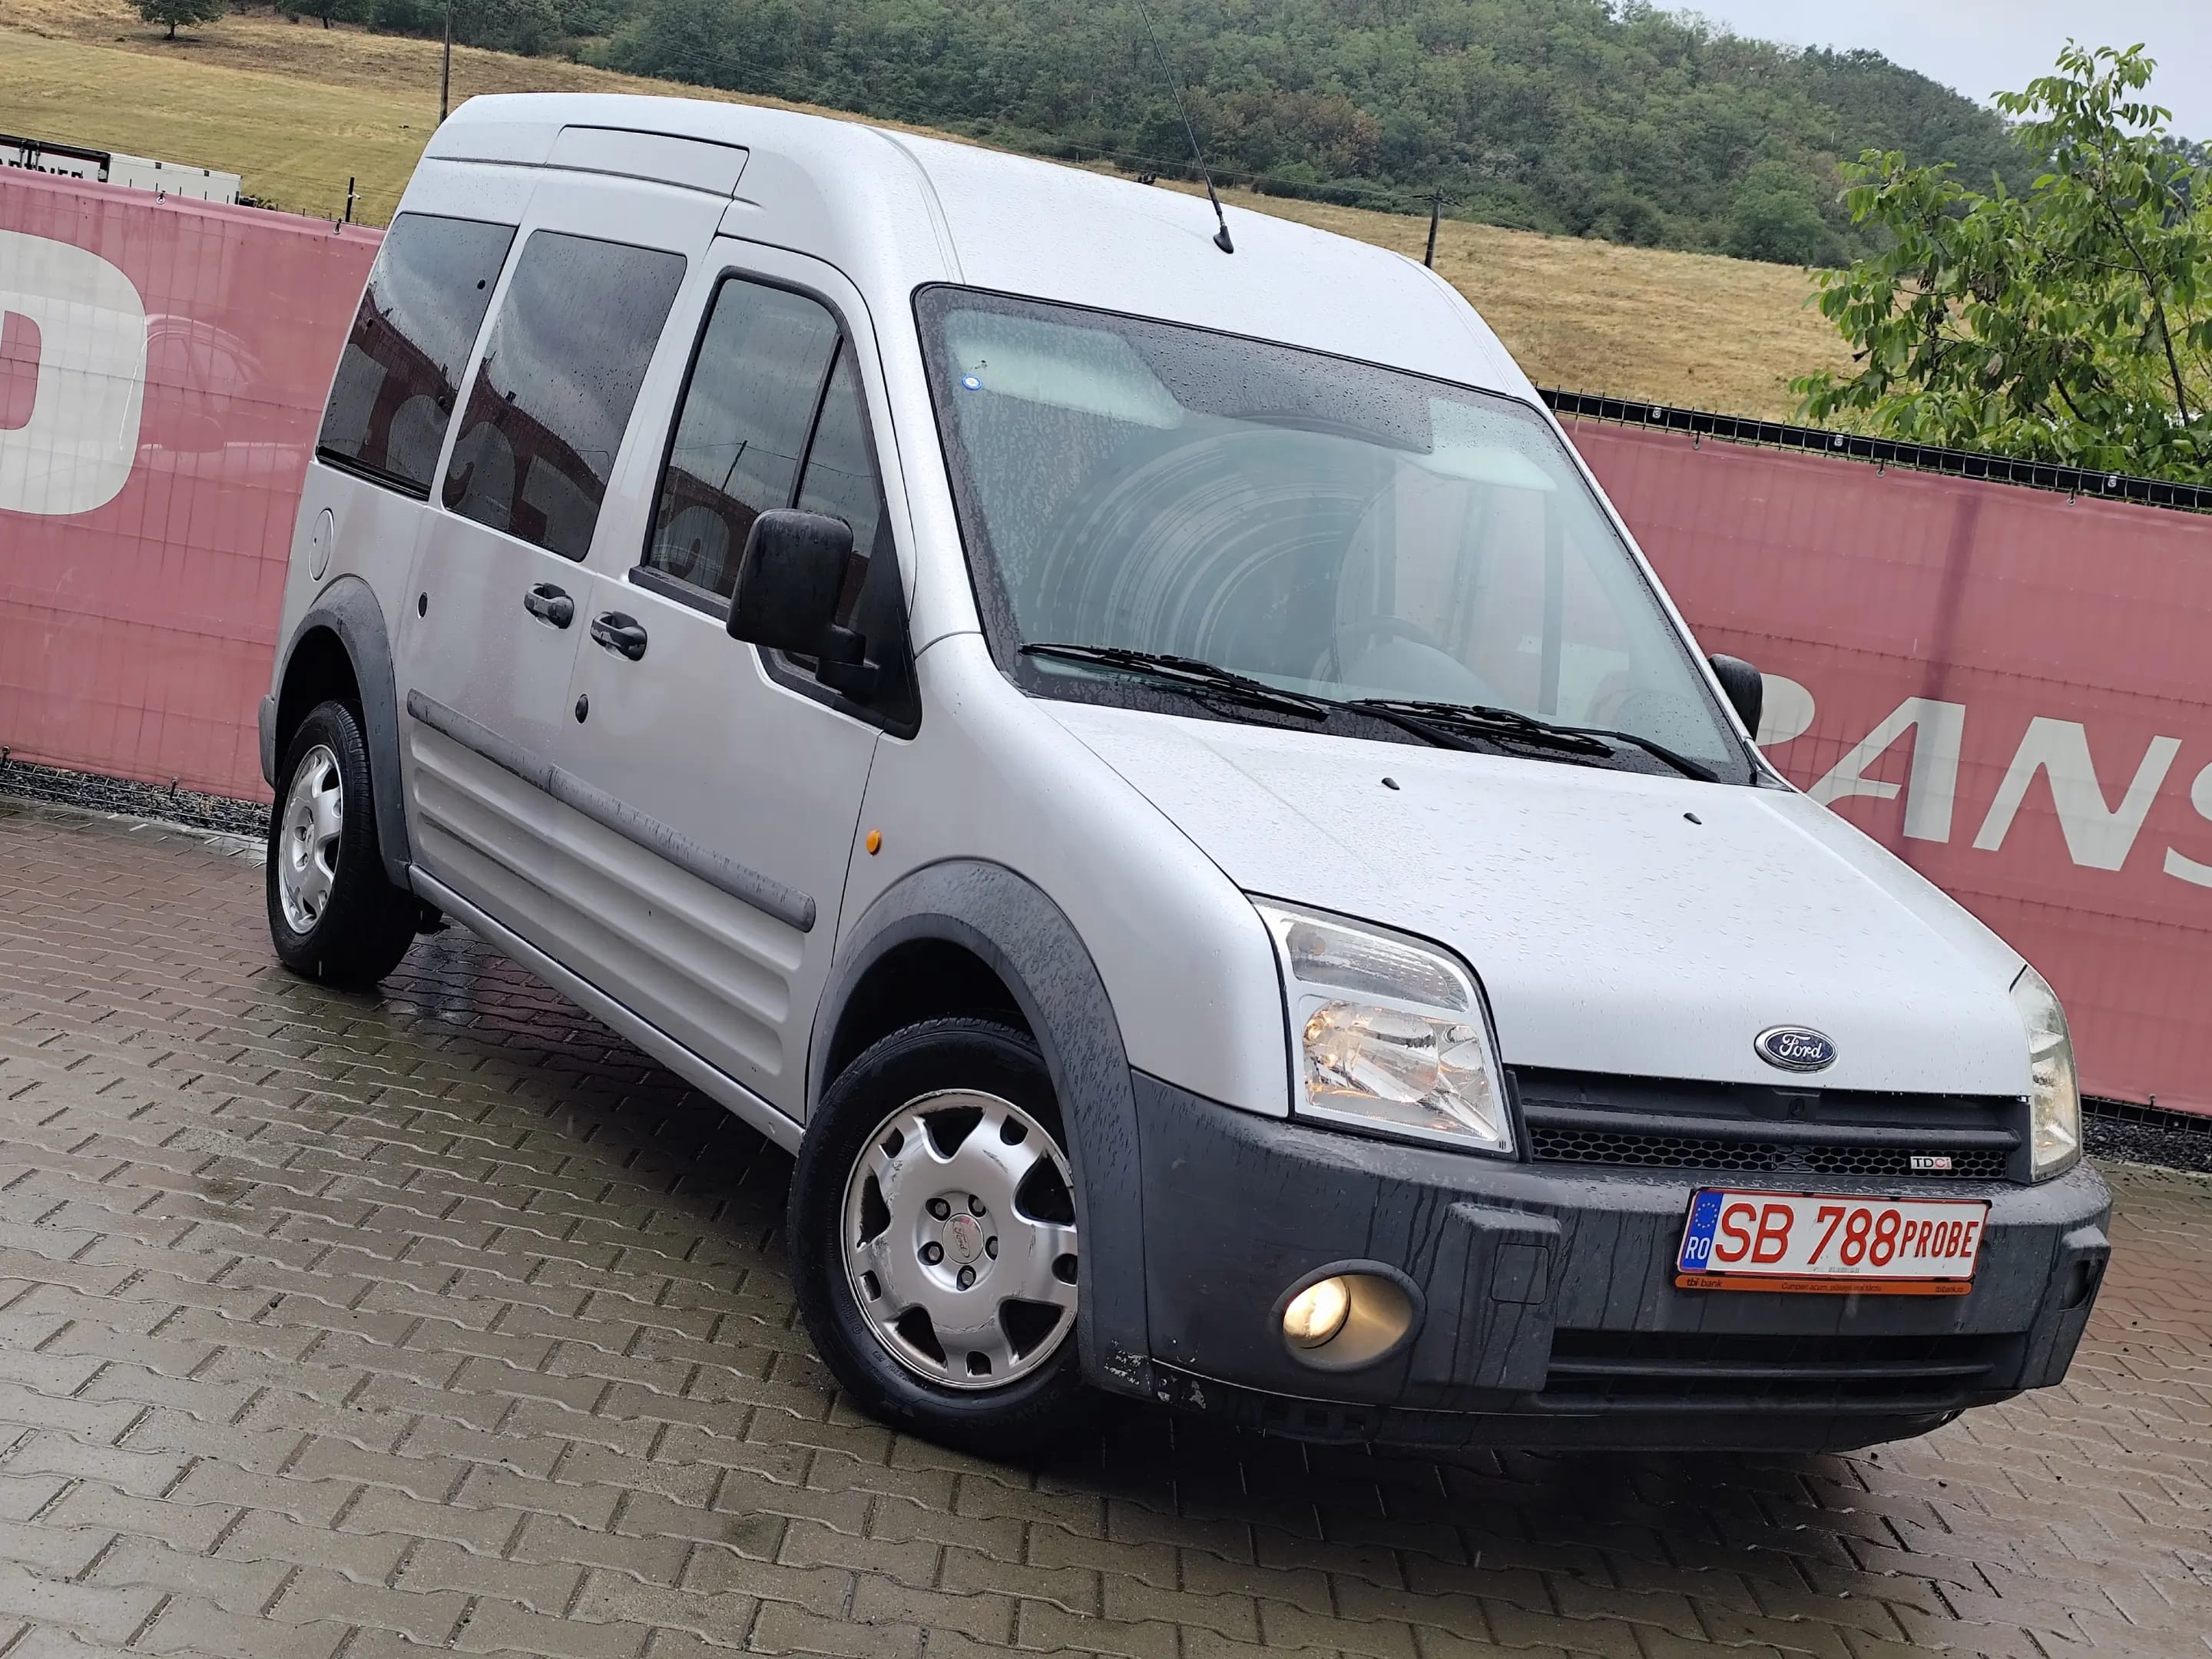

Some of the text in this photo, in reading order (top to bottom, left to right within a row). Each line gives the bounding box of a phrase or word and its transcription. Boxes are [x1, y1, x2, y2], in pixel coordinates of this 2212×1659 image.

[1779, 1033, 1823, 1059] Ford
[1912, 1157, 1952, 1168] TDCi
[1715, 1202, 1979, 1267] SB 788 PROBE
[1684, 1236, 1710, 1260] RO
[1686, 1277, 1723, 1288] tbi bank
